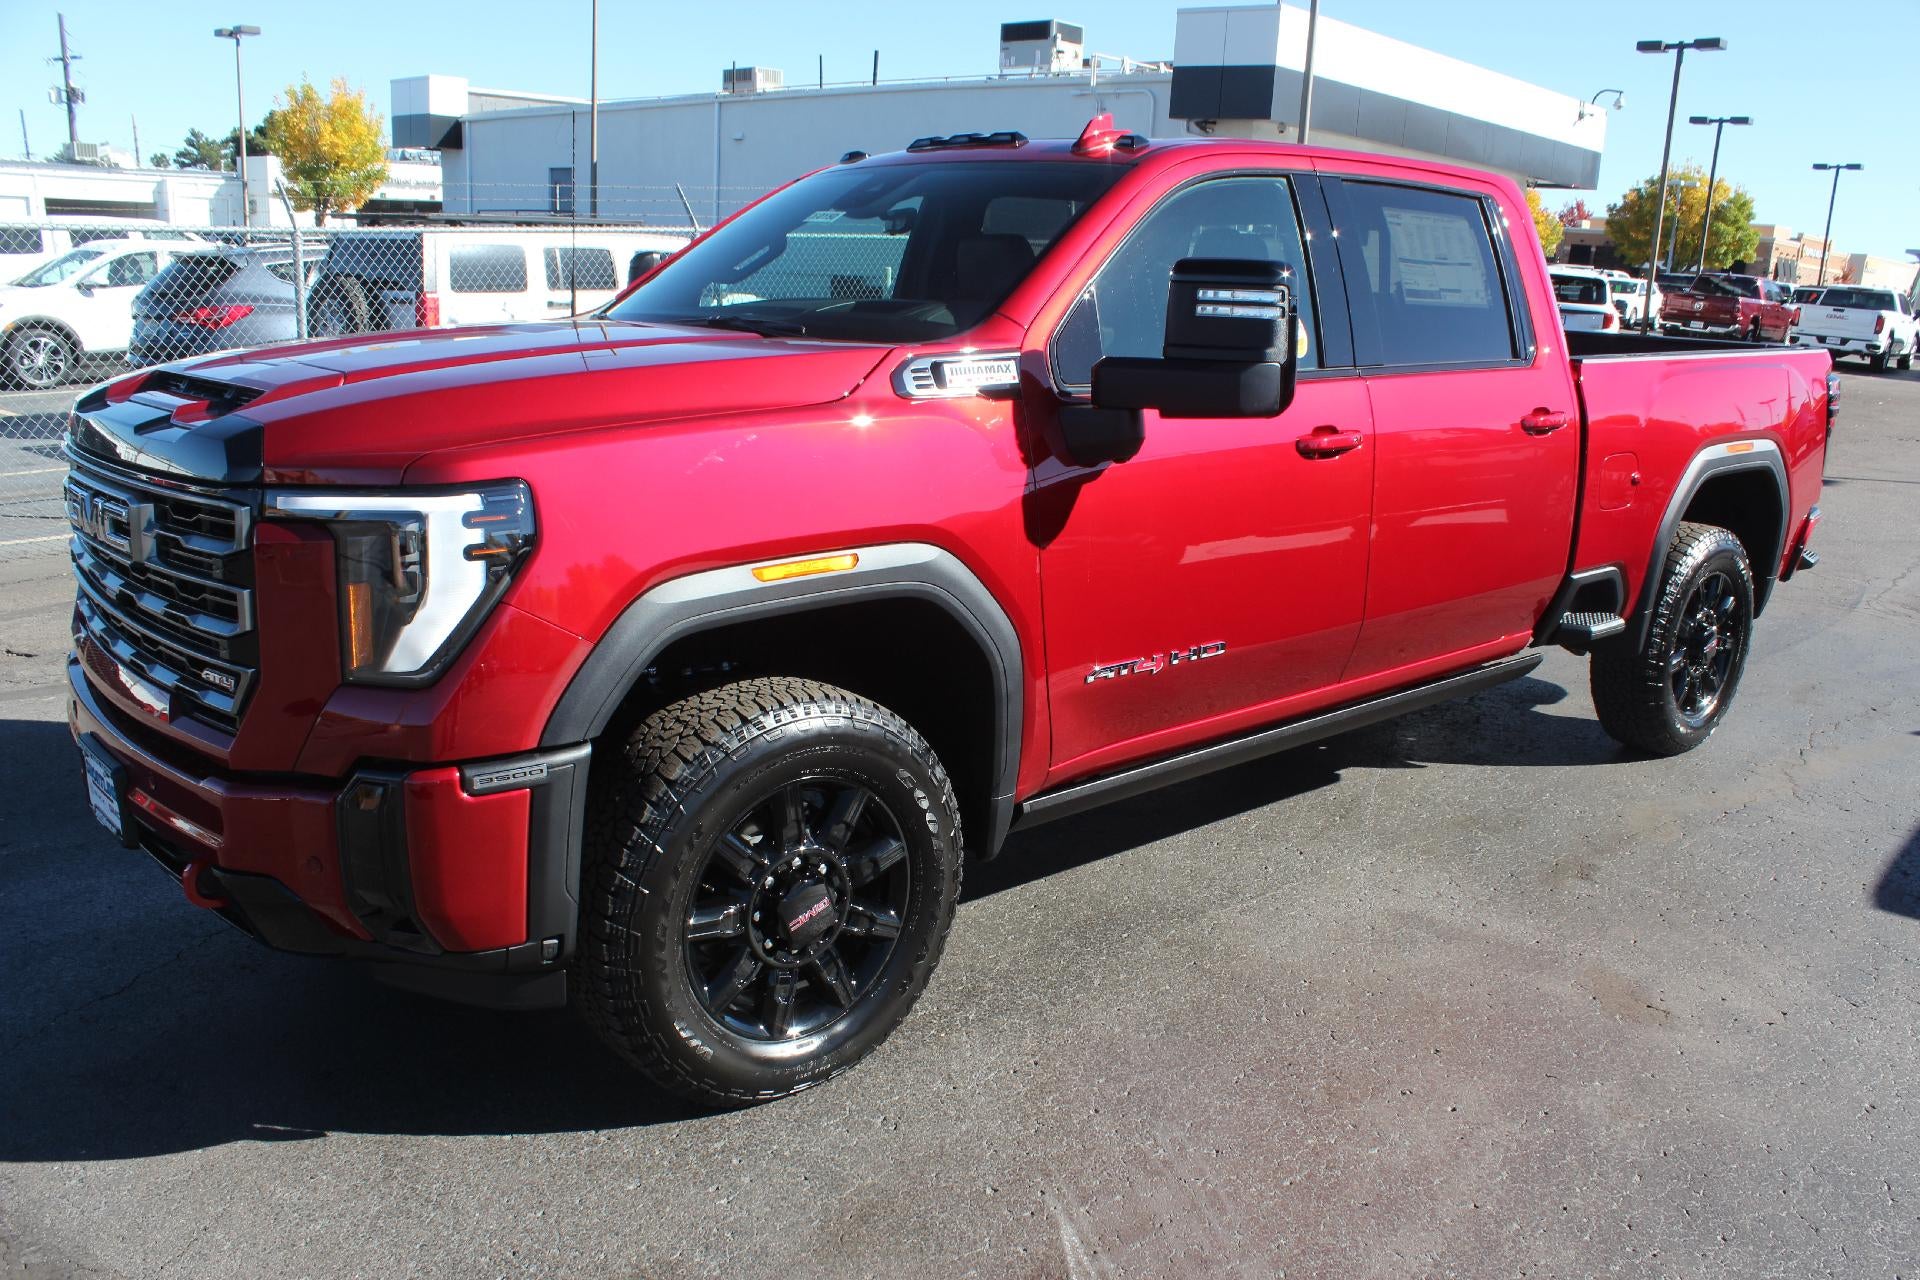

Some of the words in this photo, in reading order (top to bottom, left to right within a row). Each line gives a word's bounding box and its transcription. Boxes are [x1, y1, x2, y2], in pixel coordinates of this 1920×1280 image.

[68, 484, 131, 553] GMC
[201, 668, 235, 692] AT4
[1084, 654, 1164, 684] AT4
[1170, 641, 1226, 665] HD
[789, 896, 830, 931] GMC
